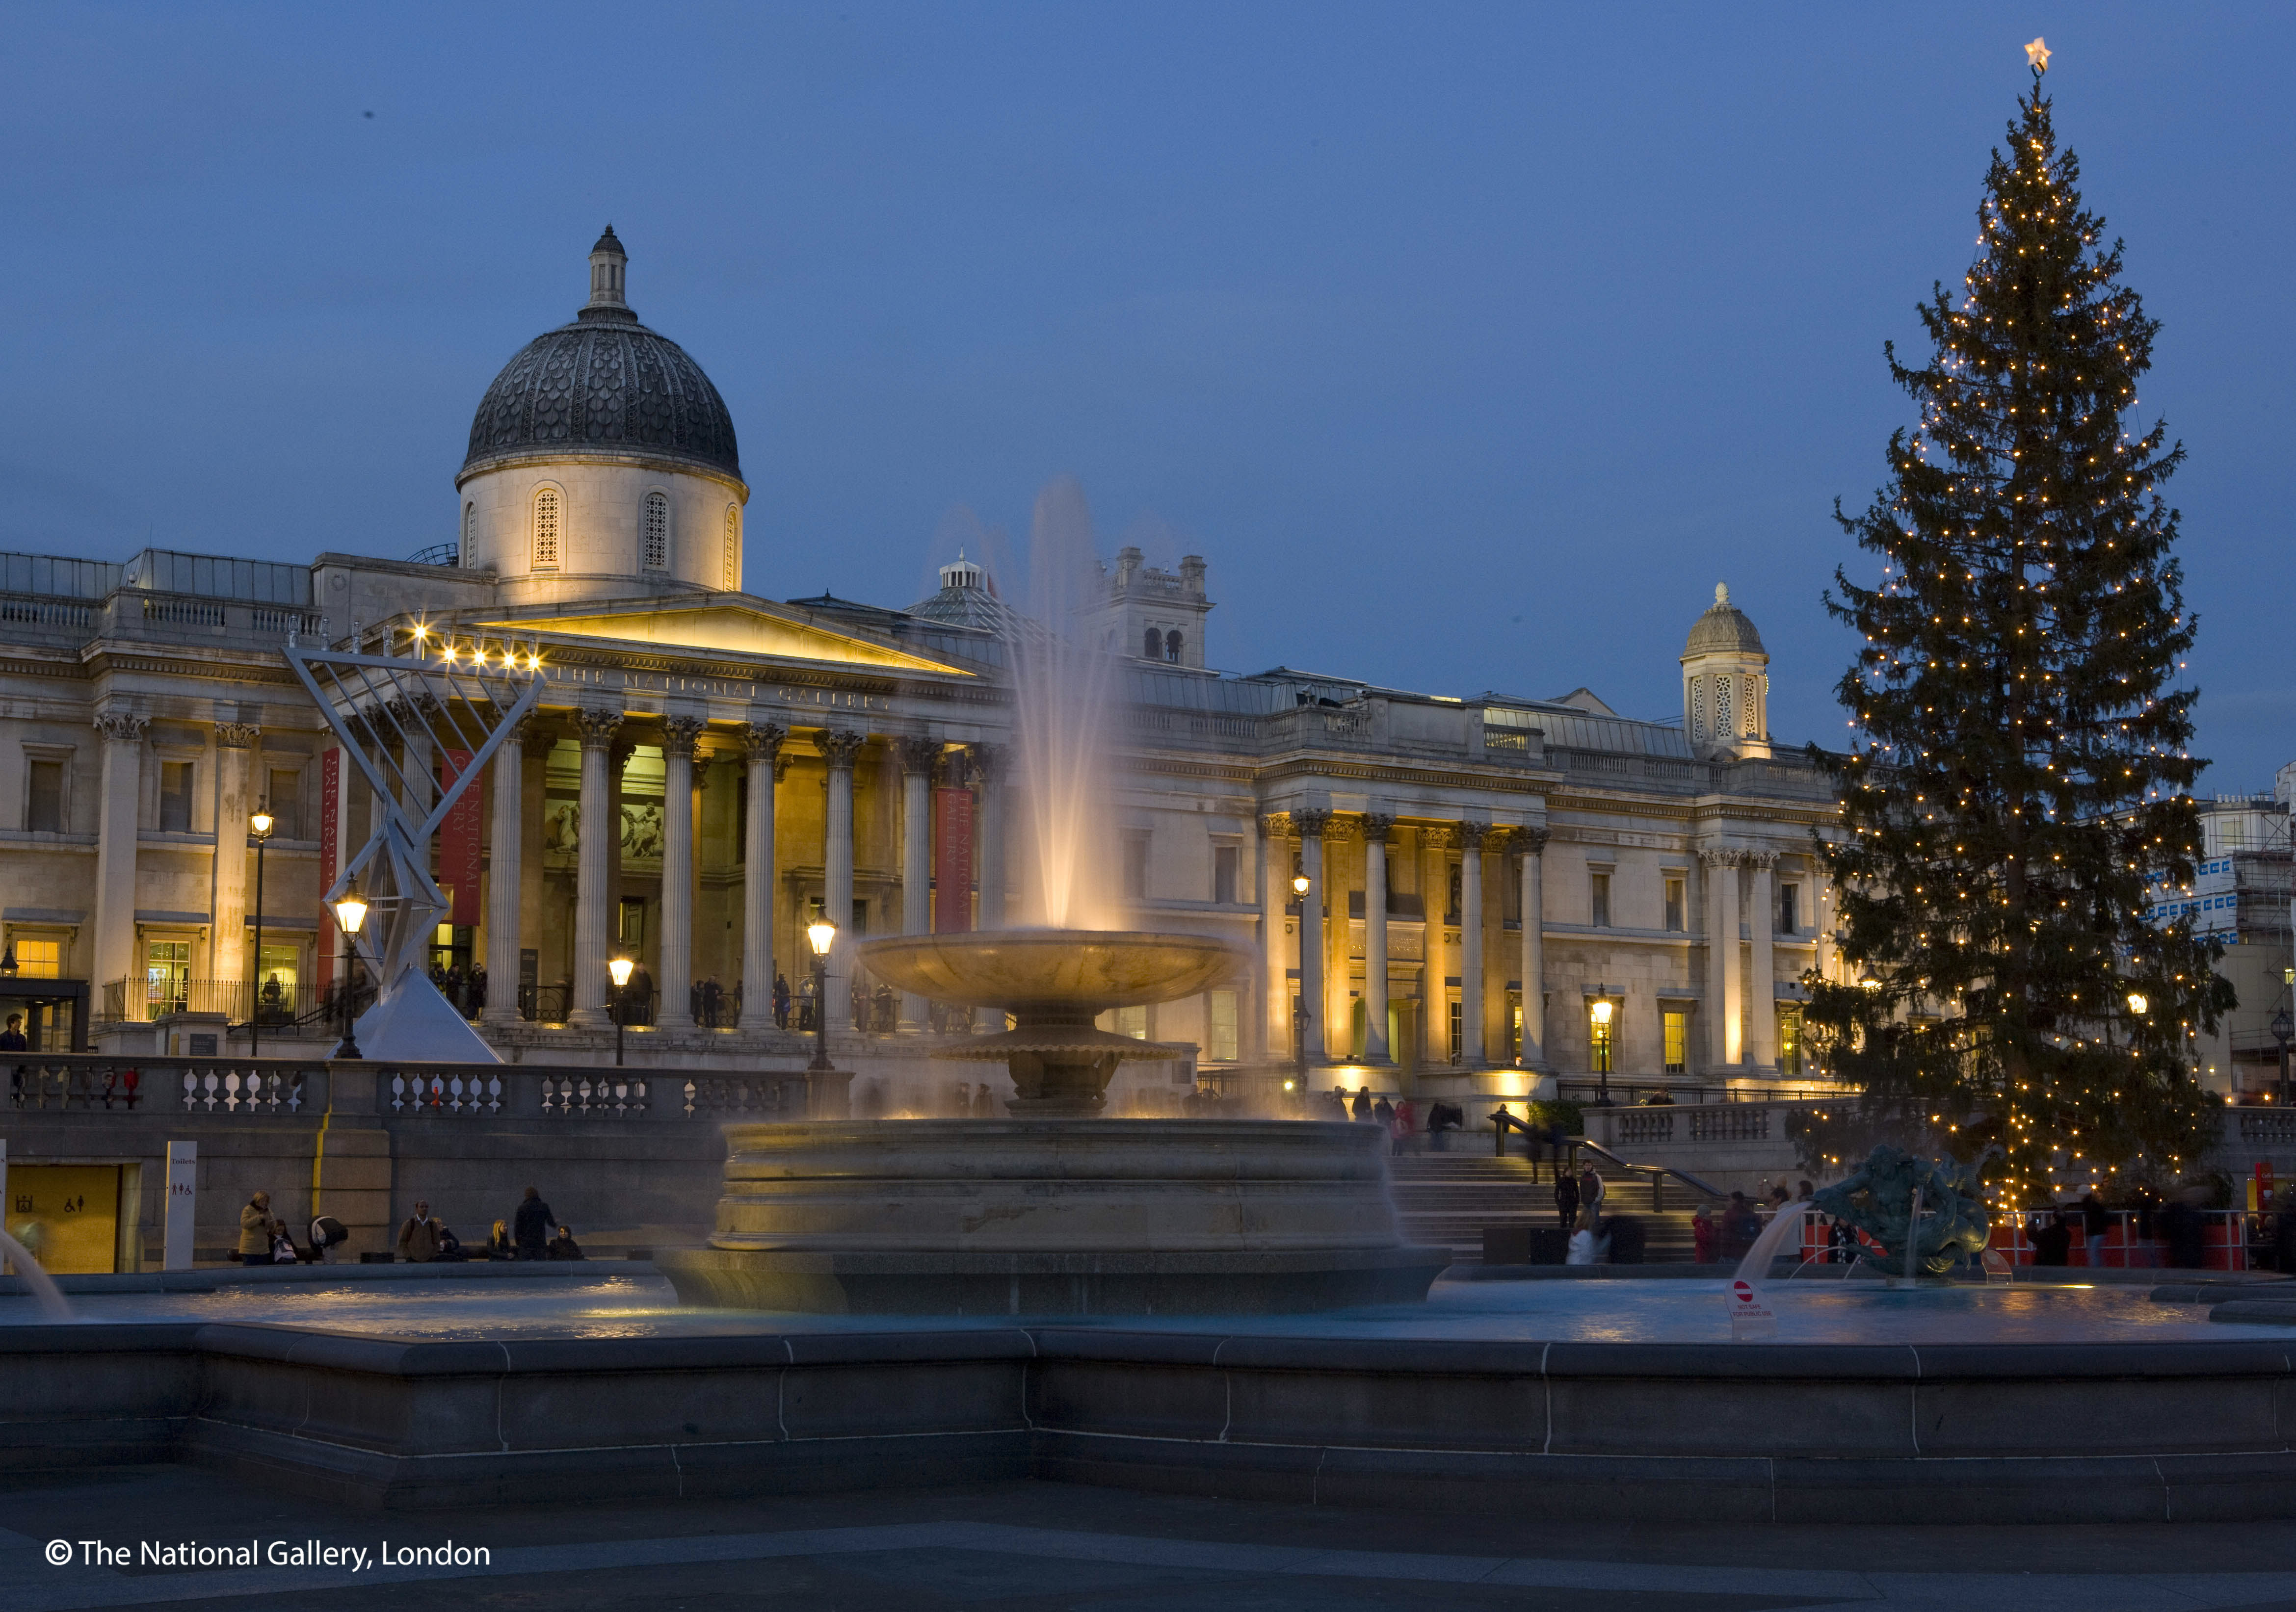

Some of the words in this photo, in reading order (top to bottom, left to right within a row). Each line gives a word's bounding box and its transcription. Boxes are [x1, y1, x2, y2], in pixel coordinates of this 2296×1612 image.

[552, 666, 605, 684] THE
[624, 673, 760, 699] NATIONAL
[779, 687, 891, 710] GALLERY
[453, 756, 466, 836] GERY
[947, 793, 956, 866] GALLERY
[959, 795, 969, 828] THE
[326, 808, 335, 921] NATION
[466, 800, 479, 892] NATIONAL
[958, 833, 969, 915] NATIONAL
